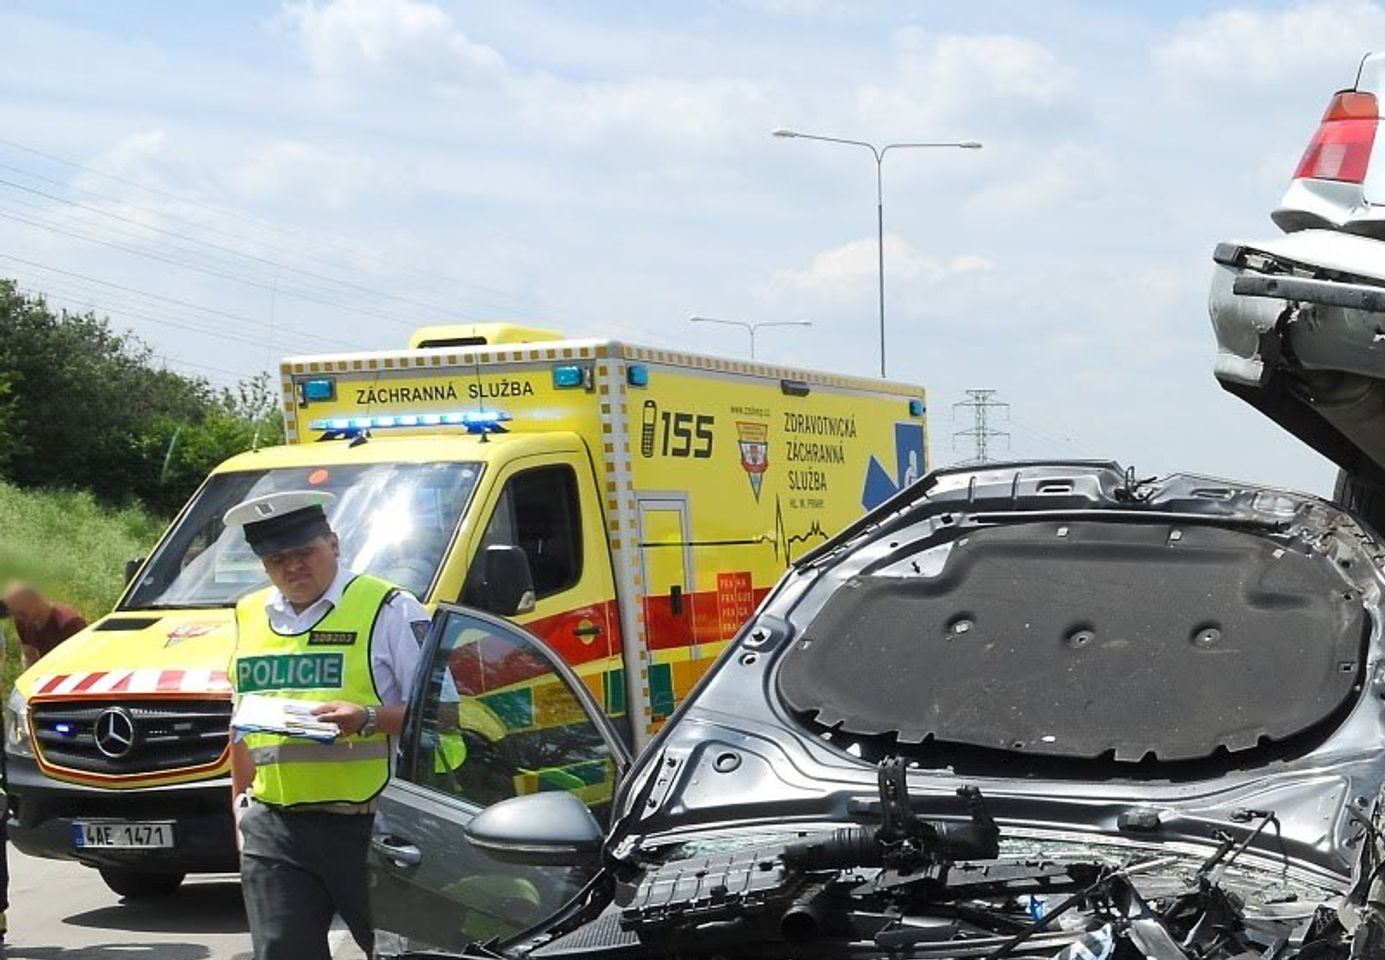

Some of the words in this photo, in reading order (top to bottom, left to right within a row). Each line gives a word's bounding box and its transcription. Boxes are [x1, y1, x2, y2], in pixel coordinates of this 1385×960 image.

[356, 382, 457, 405] ZÁCHRANNÁ
[468, 379, 534, 399] SLUŽBA
[661, 411, 714, 458] 155
[784, 412, 857, 438] ZDRAVOTNICKÁ
[786, 436, 845, 464] ZÁCHRANNÁ
[788, 466, 827, 491] SLUŽBA
[237, 657, 340, 687] POLICIE
[86, 825, 114, 846] 4AE
[124, 826, 164, 846] 1471
